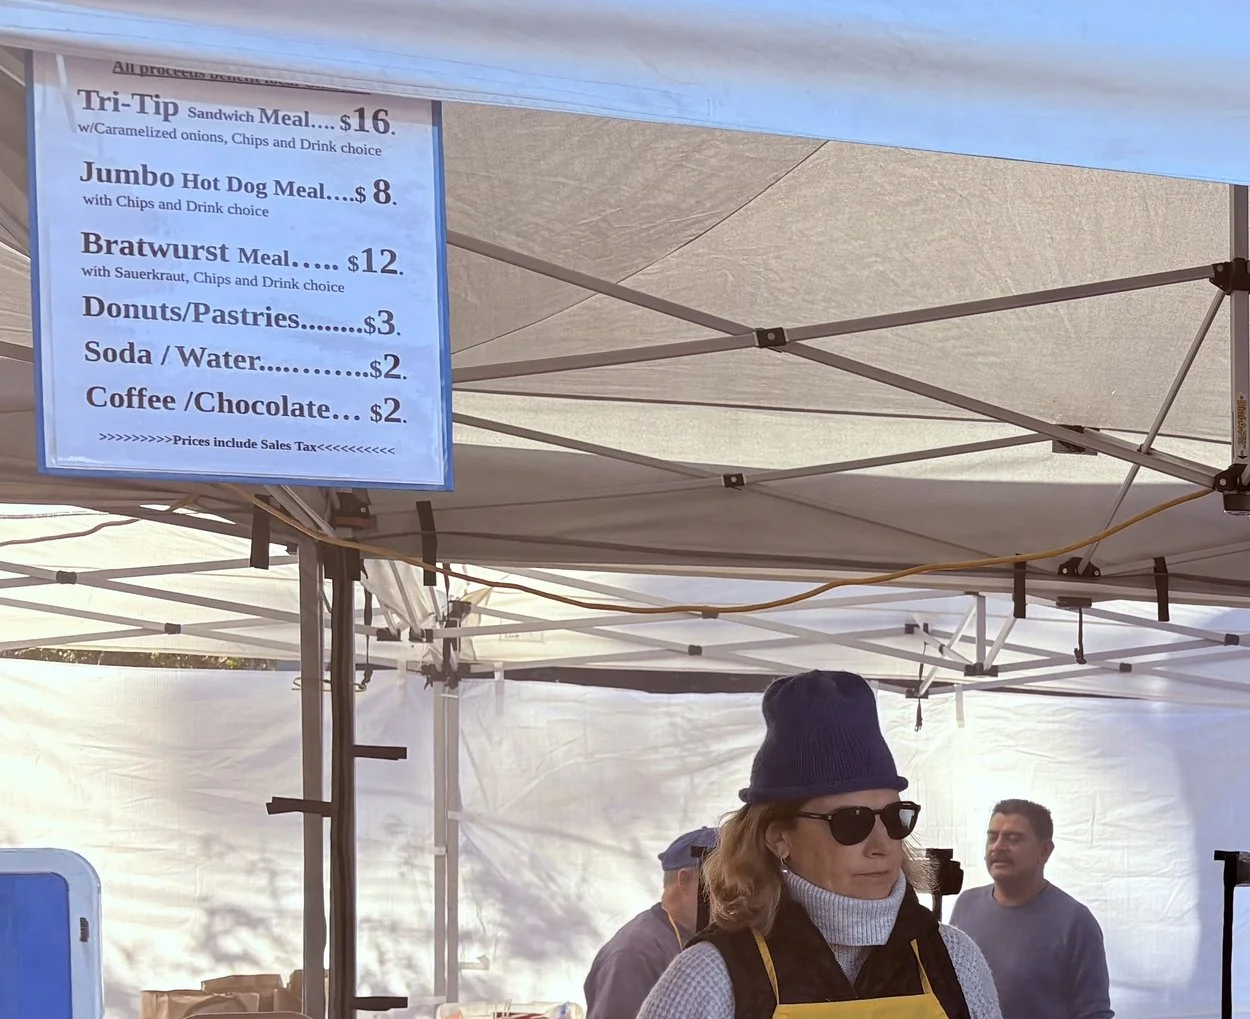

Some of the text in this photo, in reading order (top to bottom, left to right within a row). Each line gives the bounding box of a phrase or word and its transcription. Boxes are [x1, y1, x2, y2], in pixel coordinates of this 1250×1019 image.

[77, 89, 180, 122] Tri-Tip
[187, 106, 255, 124] Sandwich
[77, 122, 382, 157] w/Caramelized onions, Chips and Drink choice
[80, 161, 175, 188] Jumbo
[181, 172, 219, 193] Hot
[226, 176, 268, 198] Dog
[83, 195, 270, 217] with Chips and Drink choice
[81, 231, 229, 263] Bratwurst
[81, 266, 345, 293] with Sauerkraut, Chips and Drink choice
[84, 341, 153, 365] Soda
[85, 386, 176, 410] Coffee
[213, 437, 258, 451] include
[260, 439, 292, 451] Sales
